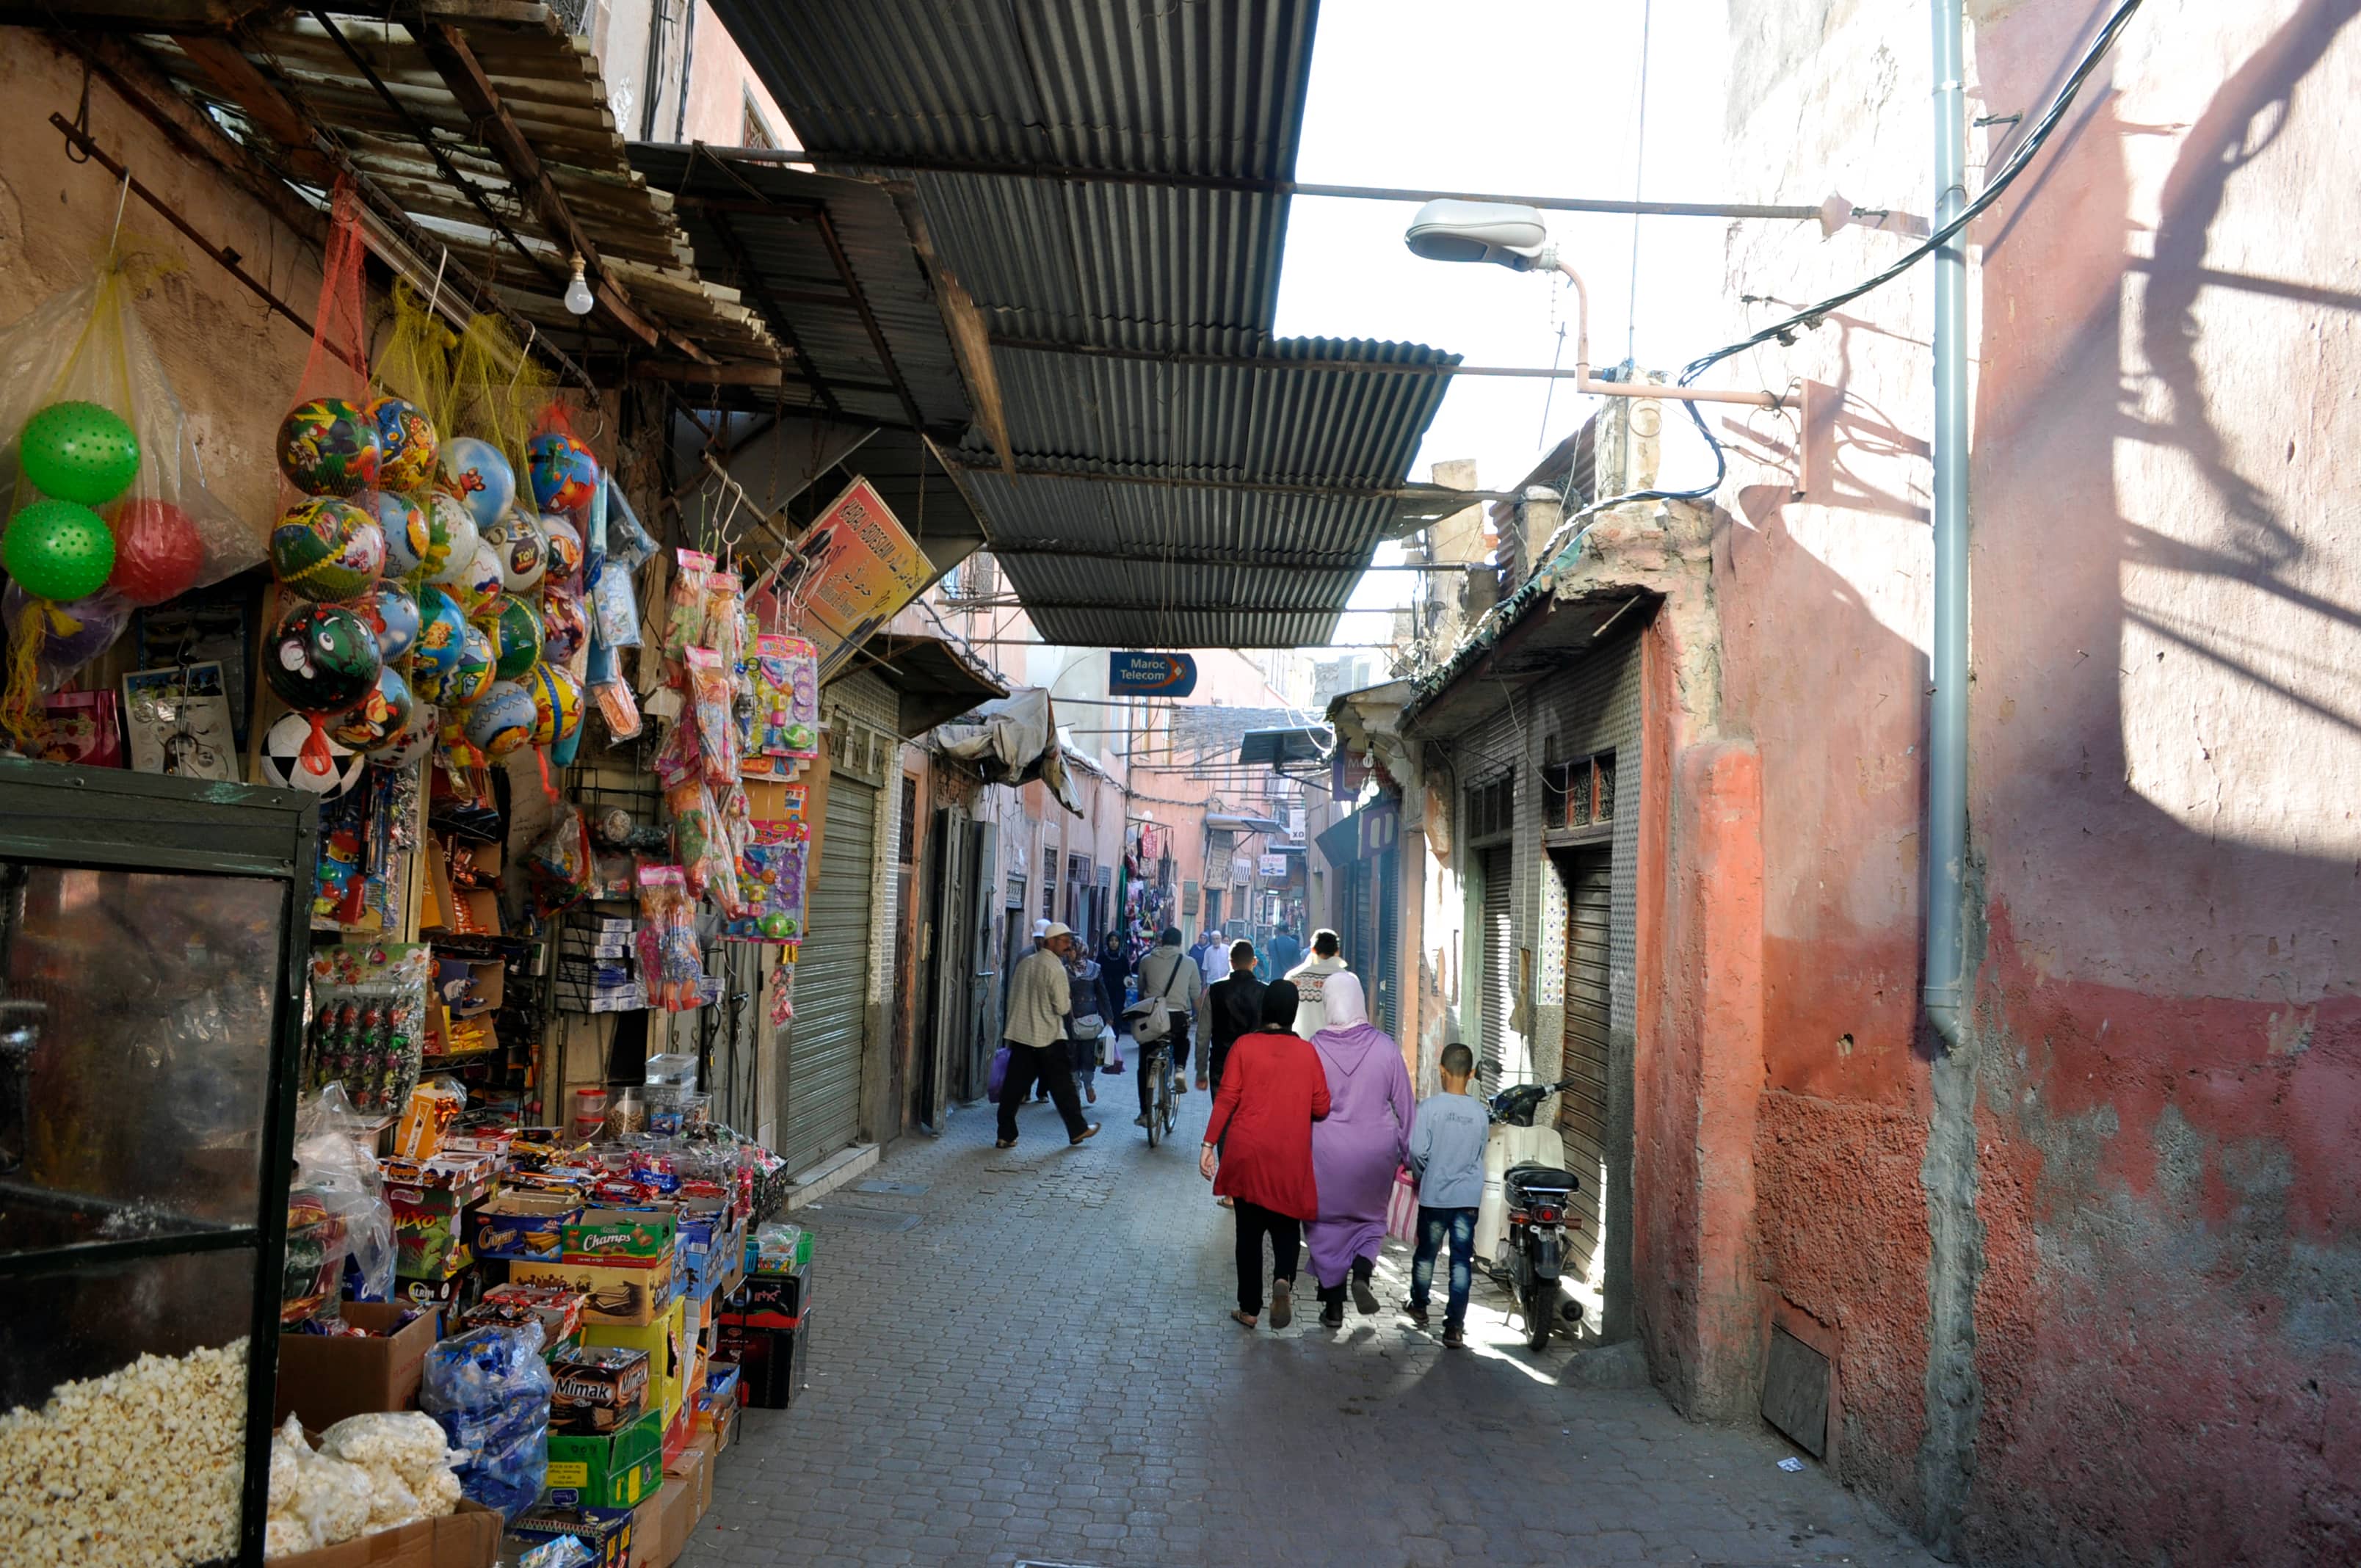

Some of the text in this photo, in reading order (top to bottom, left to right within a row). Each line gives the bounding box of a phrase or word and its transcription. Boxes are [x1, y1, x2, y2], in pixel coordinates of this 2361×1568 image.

[516, 547, 535, 562] TOY
[1131, 658, 1166, 669] Maroc
[1120, 669, 1165, 680] Telecom
[1262, 855, 1283, 863] cyber
[583, 1234, 631, 1252] Champs
[555, 1377, 610, 1399] Mimak
[621, 1366, 647, 1395] Mimak
